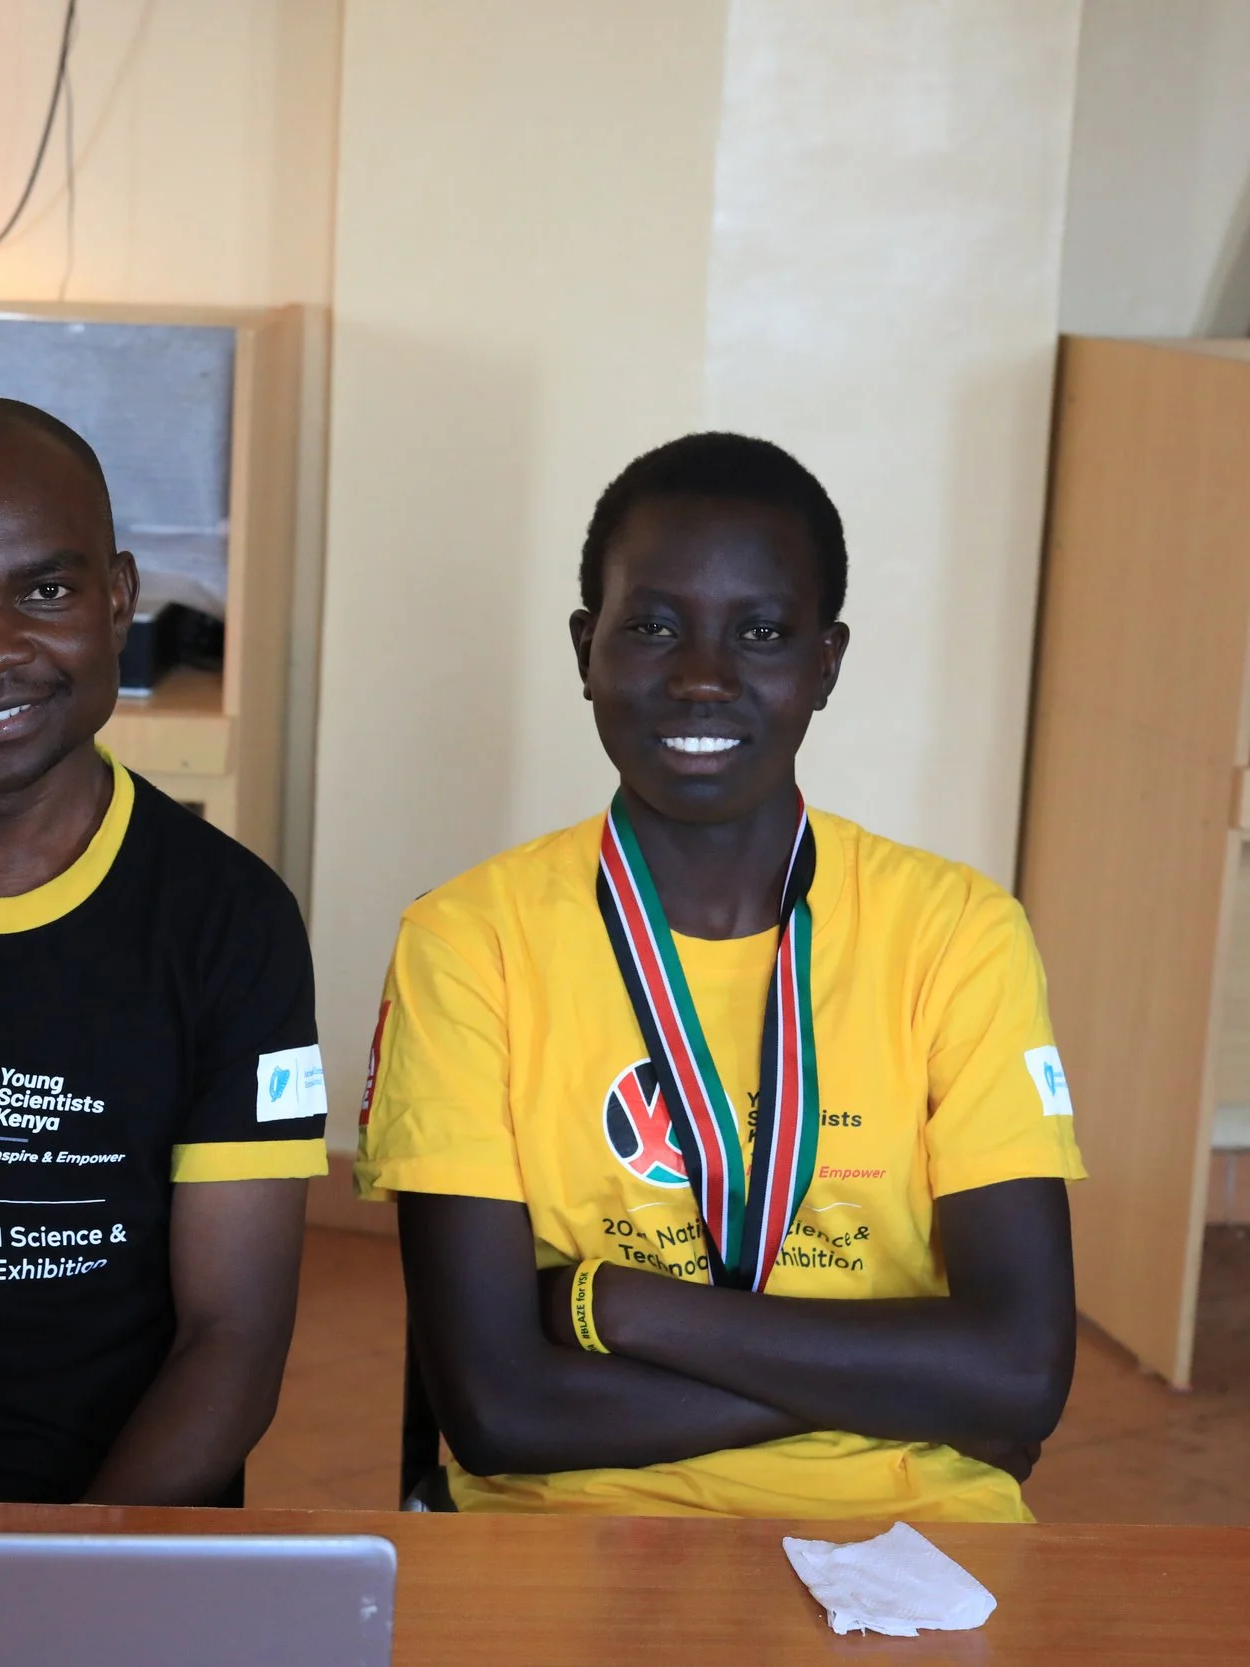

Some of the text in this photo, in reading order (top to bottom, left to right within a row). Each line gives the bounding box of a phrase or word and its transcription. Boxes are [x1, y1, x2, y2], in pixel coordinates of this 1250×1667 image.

[1, 1067, 64, 1095] Young
[41, 1151, 53, 1163] &
[56, 1151, 126, 1166] Empower
[819, 1165, 886, 1181] Empower
[10, 1226, 103, 1248] Science
[109, 1223, 127, 1243] &
[854, 1226, 870, 1240] &
[775, 1246, 864, 1271] hibition
[576, 1271, 591, 1340] #BLAZE for YSK
